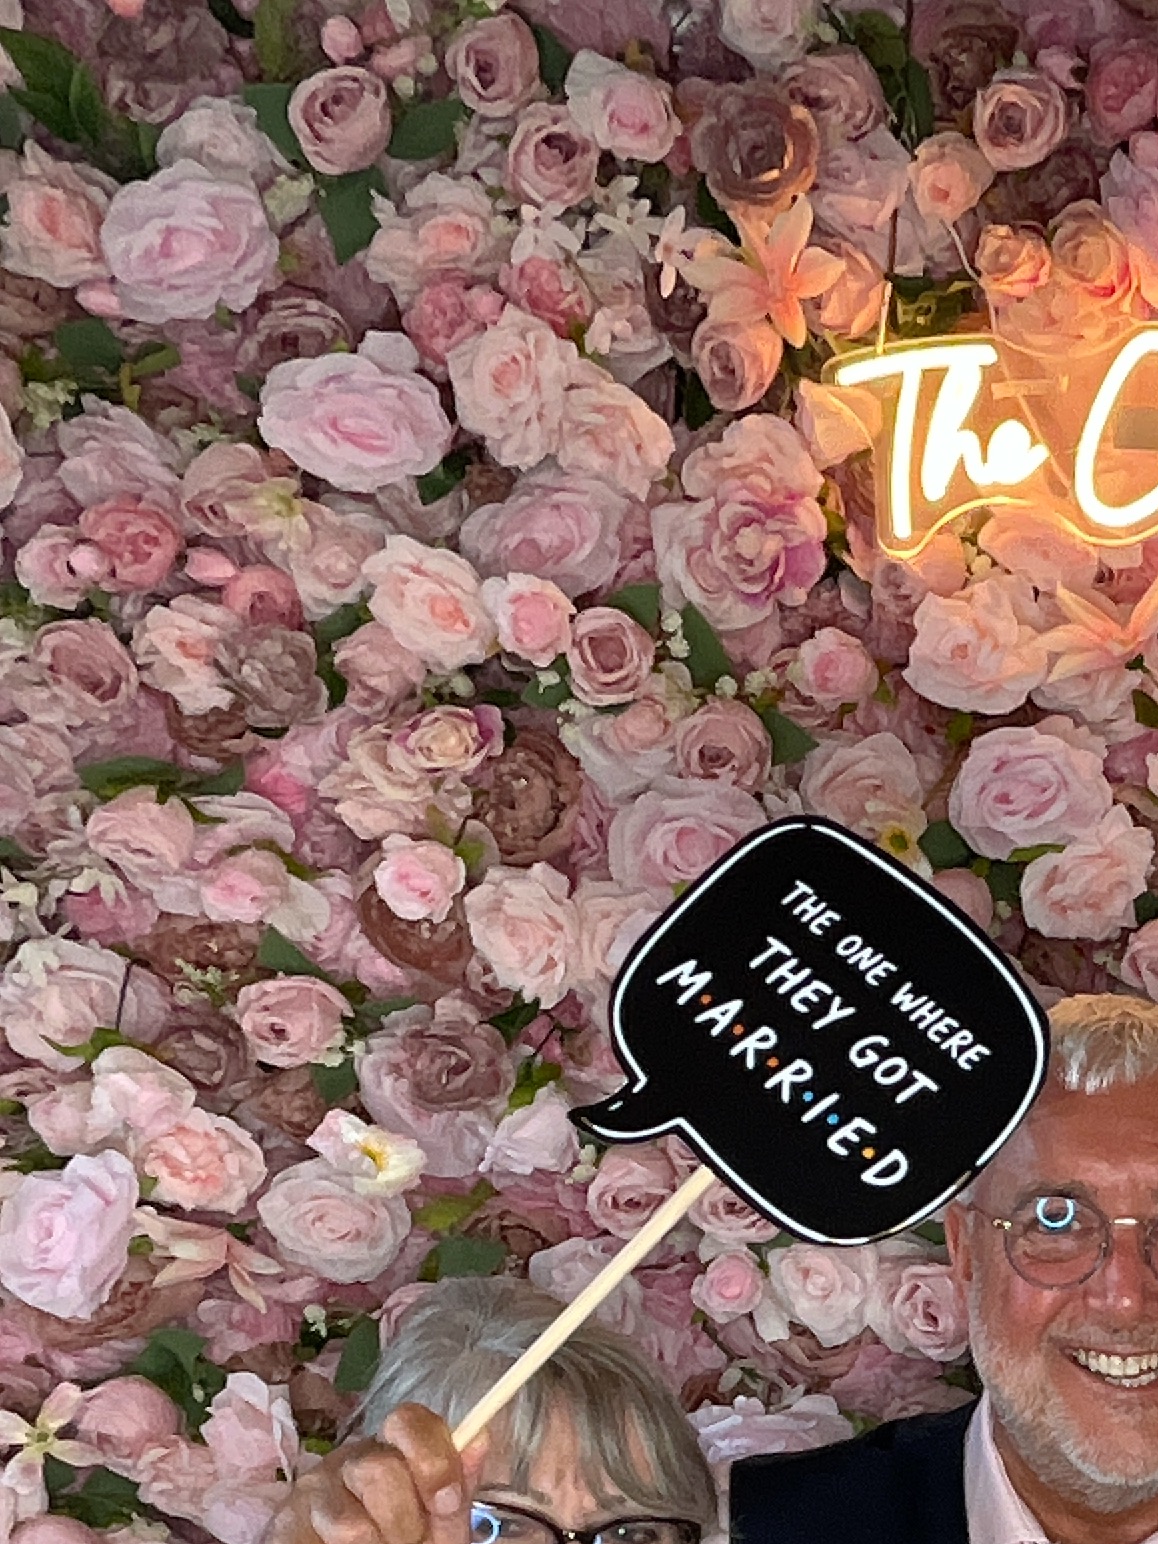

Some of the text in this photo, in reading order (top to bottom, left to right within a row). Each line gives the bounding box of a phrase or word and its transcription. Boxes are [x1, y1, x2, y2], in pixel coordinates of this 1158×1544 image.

[836, 344, 1049, 539] The
[749, 936, 940, 1104] THEY GOT
[781, 880, 992, 1071] THE ONE WHERE
